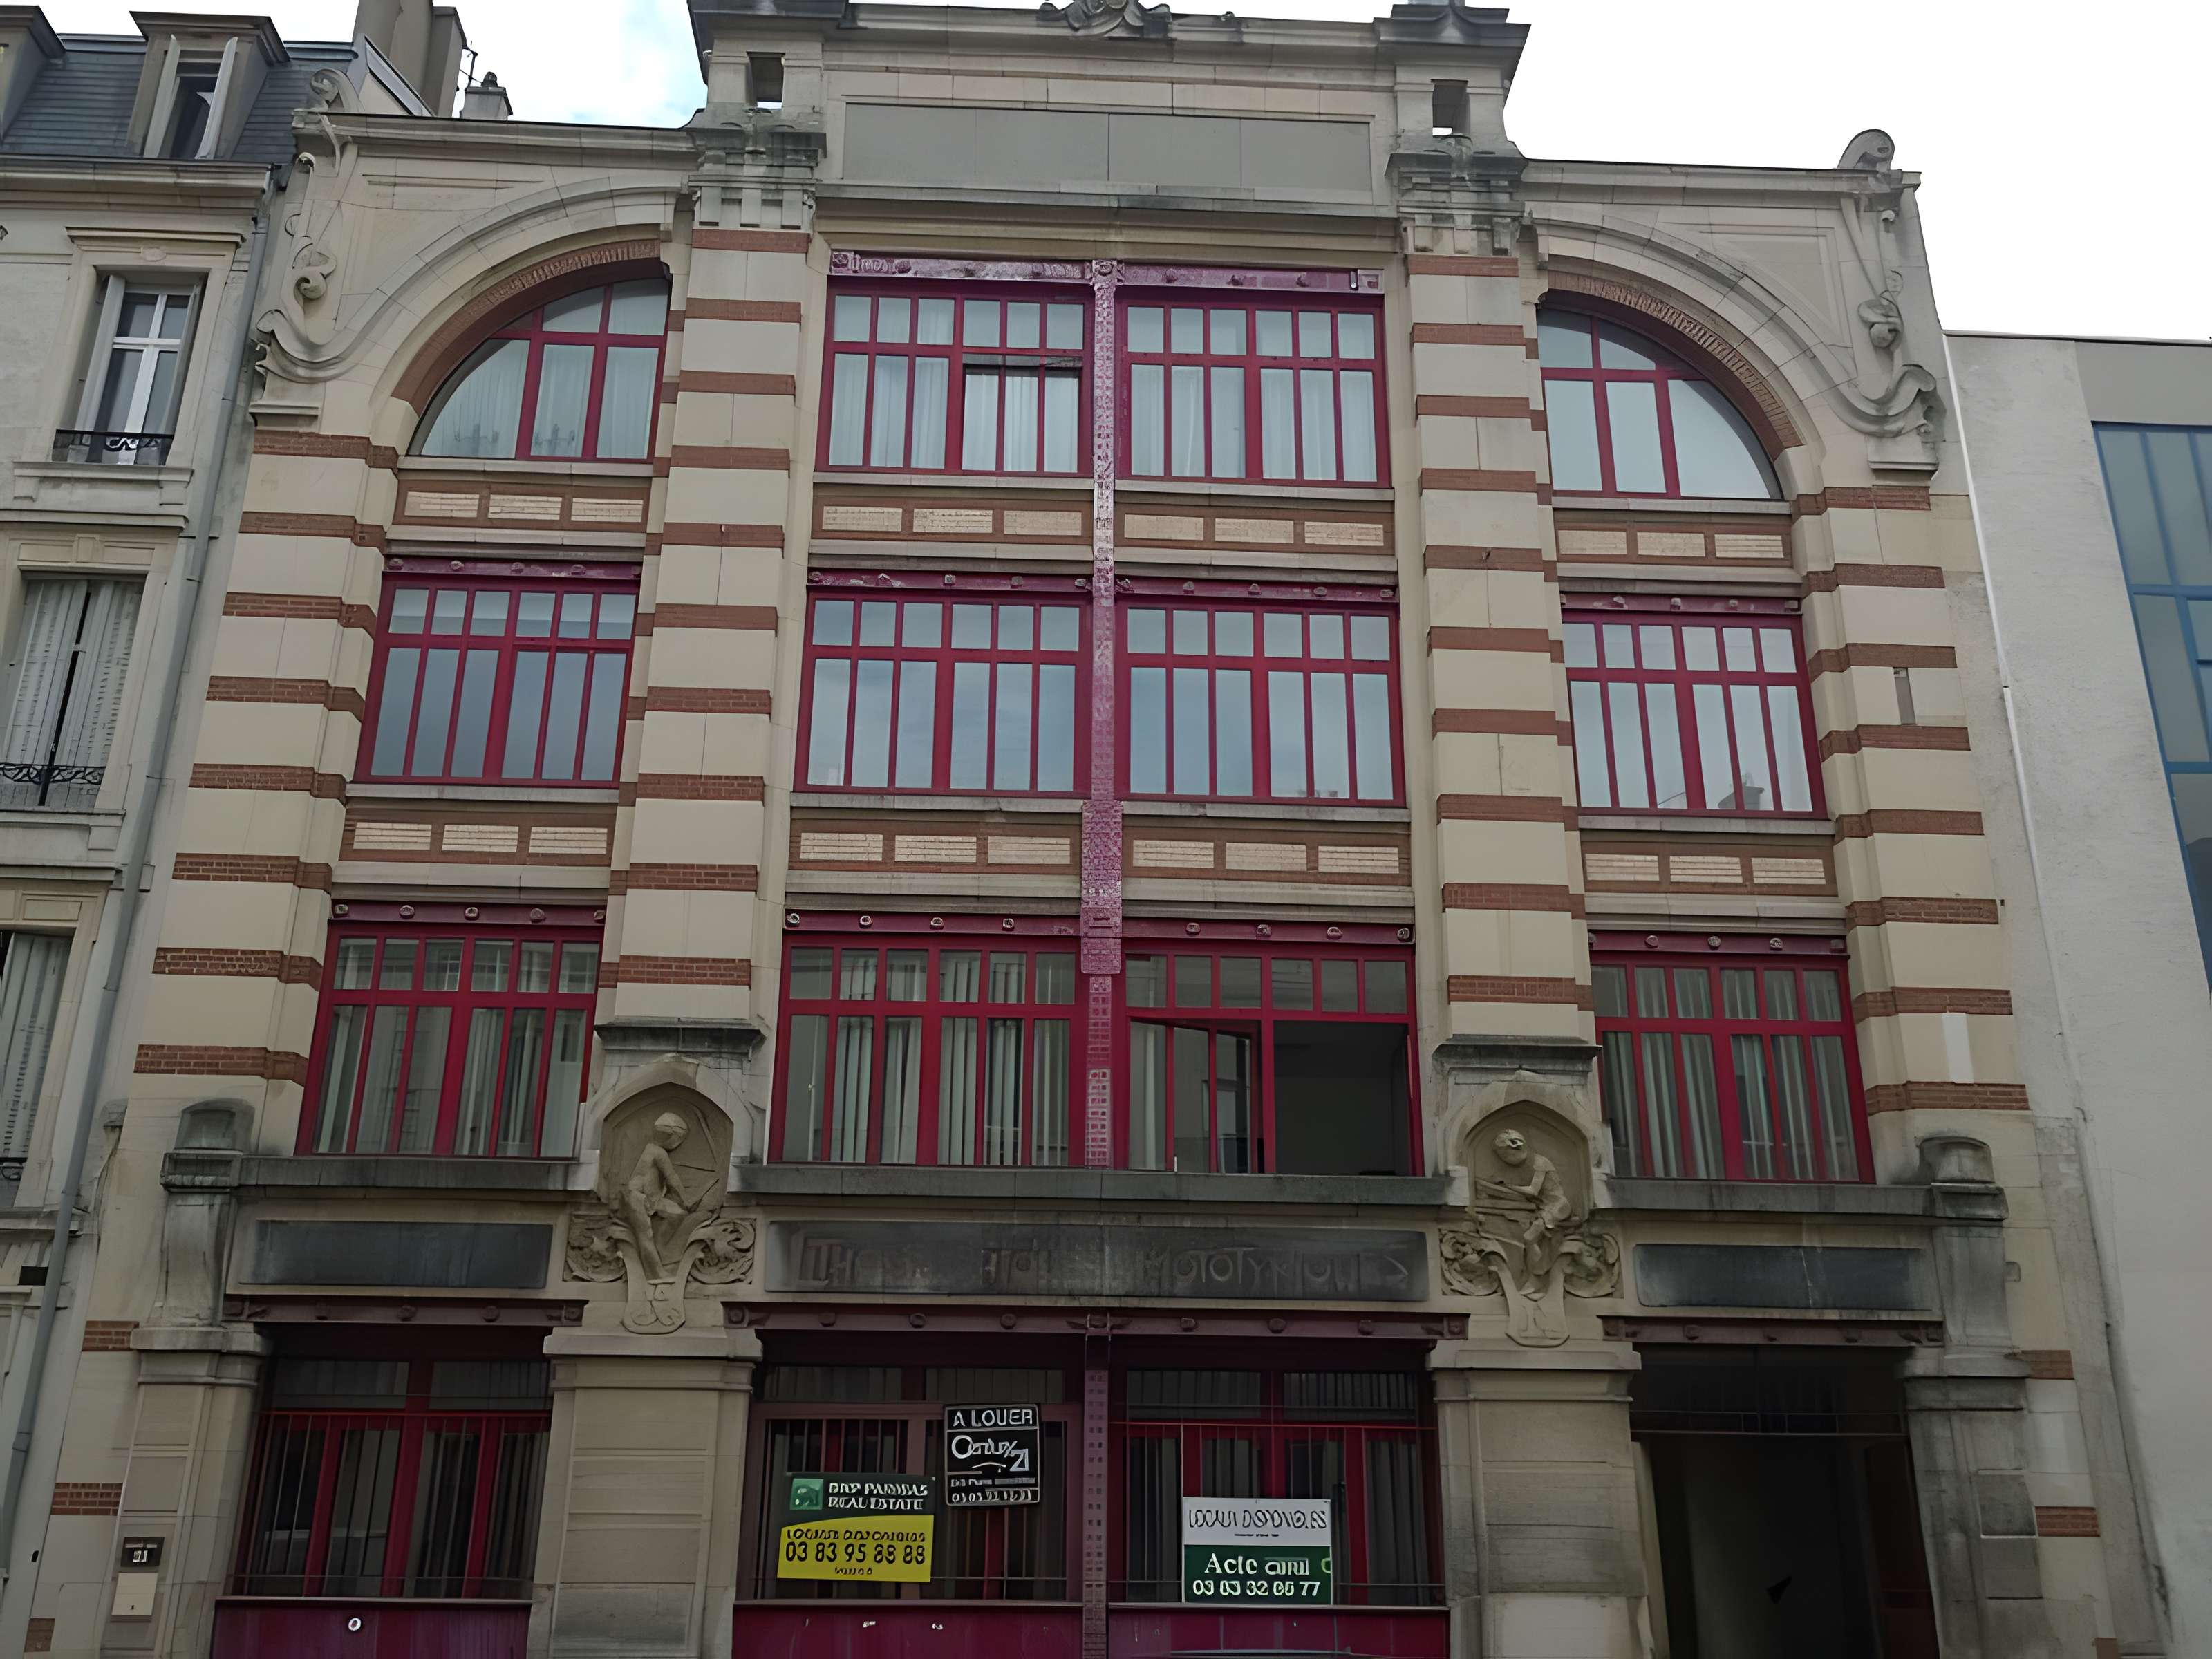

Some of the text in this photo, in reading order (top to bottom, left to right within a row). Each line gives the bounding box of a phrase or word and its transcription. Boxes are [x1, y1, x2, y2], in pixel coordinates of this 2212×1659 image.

[953, 1409, 1033, 1427] A LOUER
[785, 1541, 807, 1562] 03
[815, 1542, 837, 1563] 83
[845, 1543, 867, 1563] 95
[1192, 1580, 1215, 1595] 03
[1299, 1581, 1320, 1597] 77
